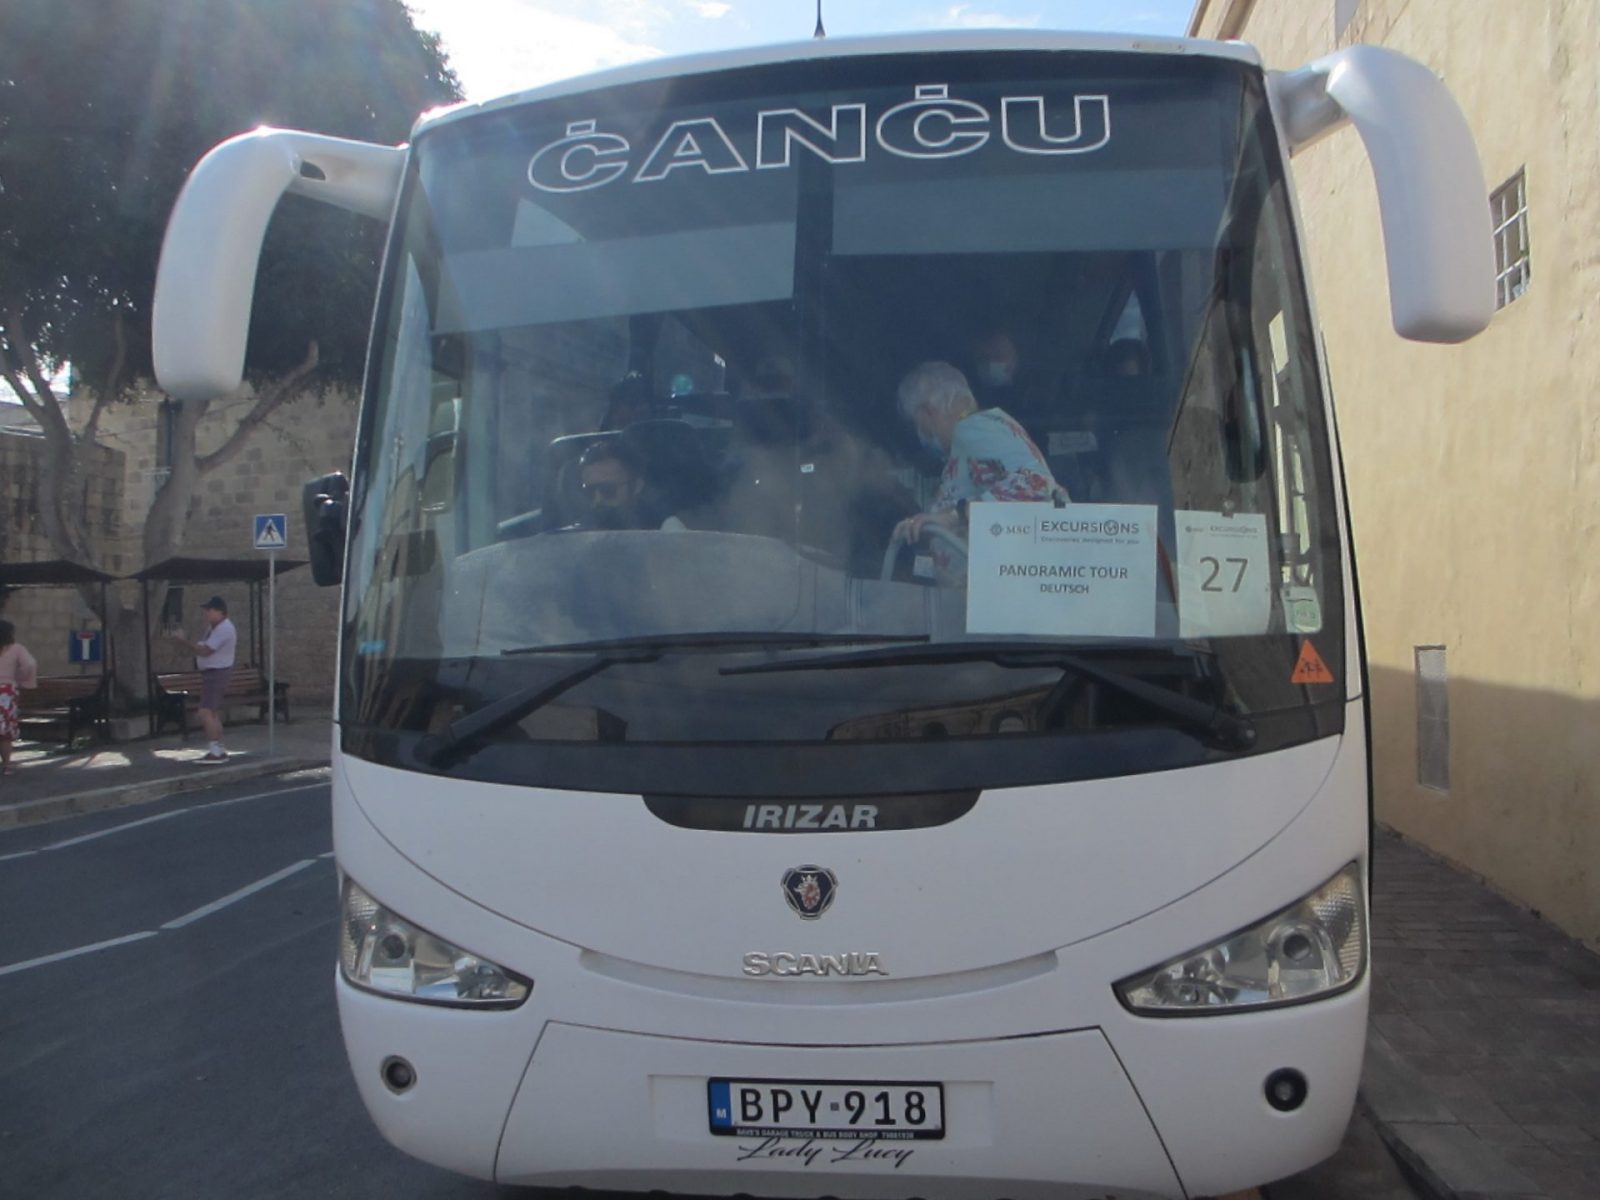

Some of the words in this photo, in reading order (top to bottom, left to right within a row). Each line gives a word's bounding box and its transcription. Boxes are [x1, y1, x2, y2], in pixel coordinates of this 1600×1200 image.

[1006, 525, 1030, 535] MSC
[1041, 519, 1140, 536] EXCURSIONS
[999, 565, 1086, 578] PANORAMIC
[1090, 566, 1129, 579] TOUR
[1200, 556, 1248, 593] 27
[1040, 584, 1090, 594] DEUTSCH
[743, 805, 878, 829] IRIZAR
[743, 952, 889, 977] SCANIA
[716, 1109, 727, 1119] M
[736, 1136, 823, 1166] Lady
[830, 1138, 914, 1168] Lucy
